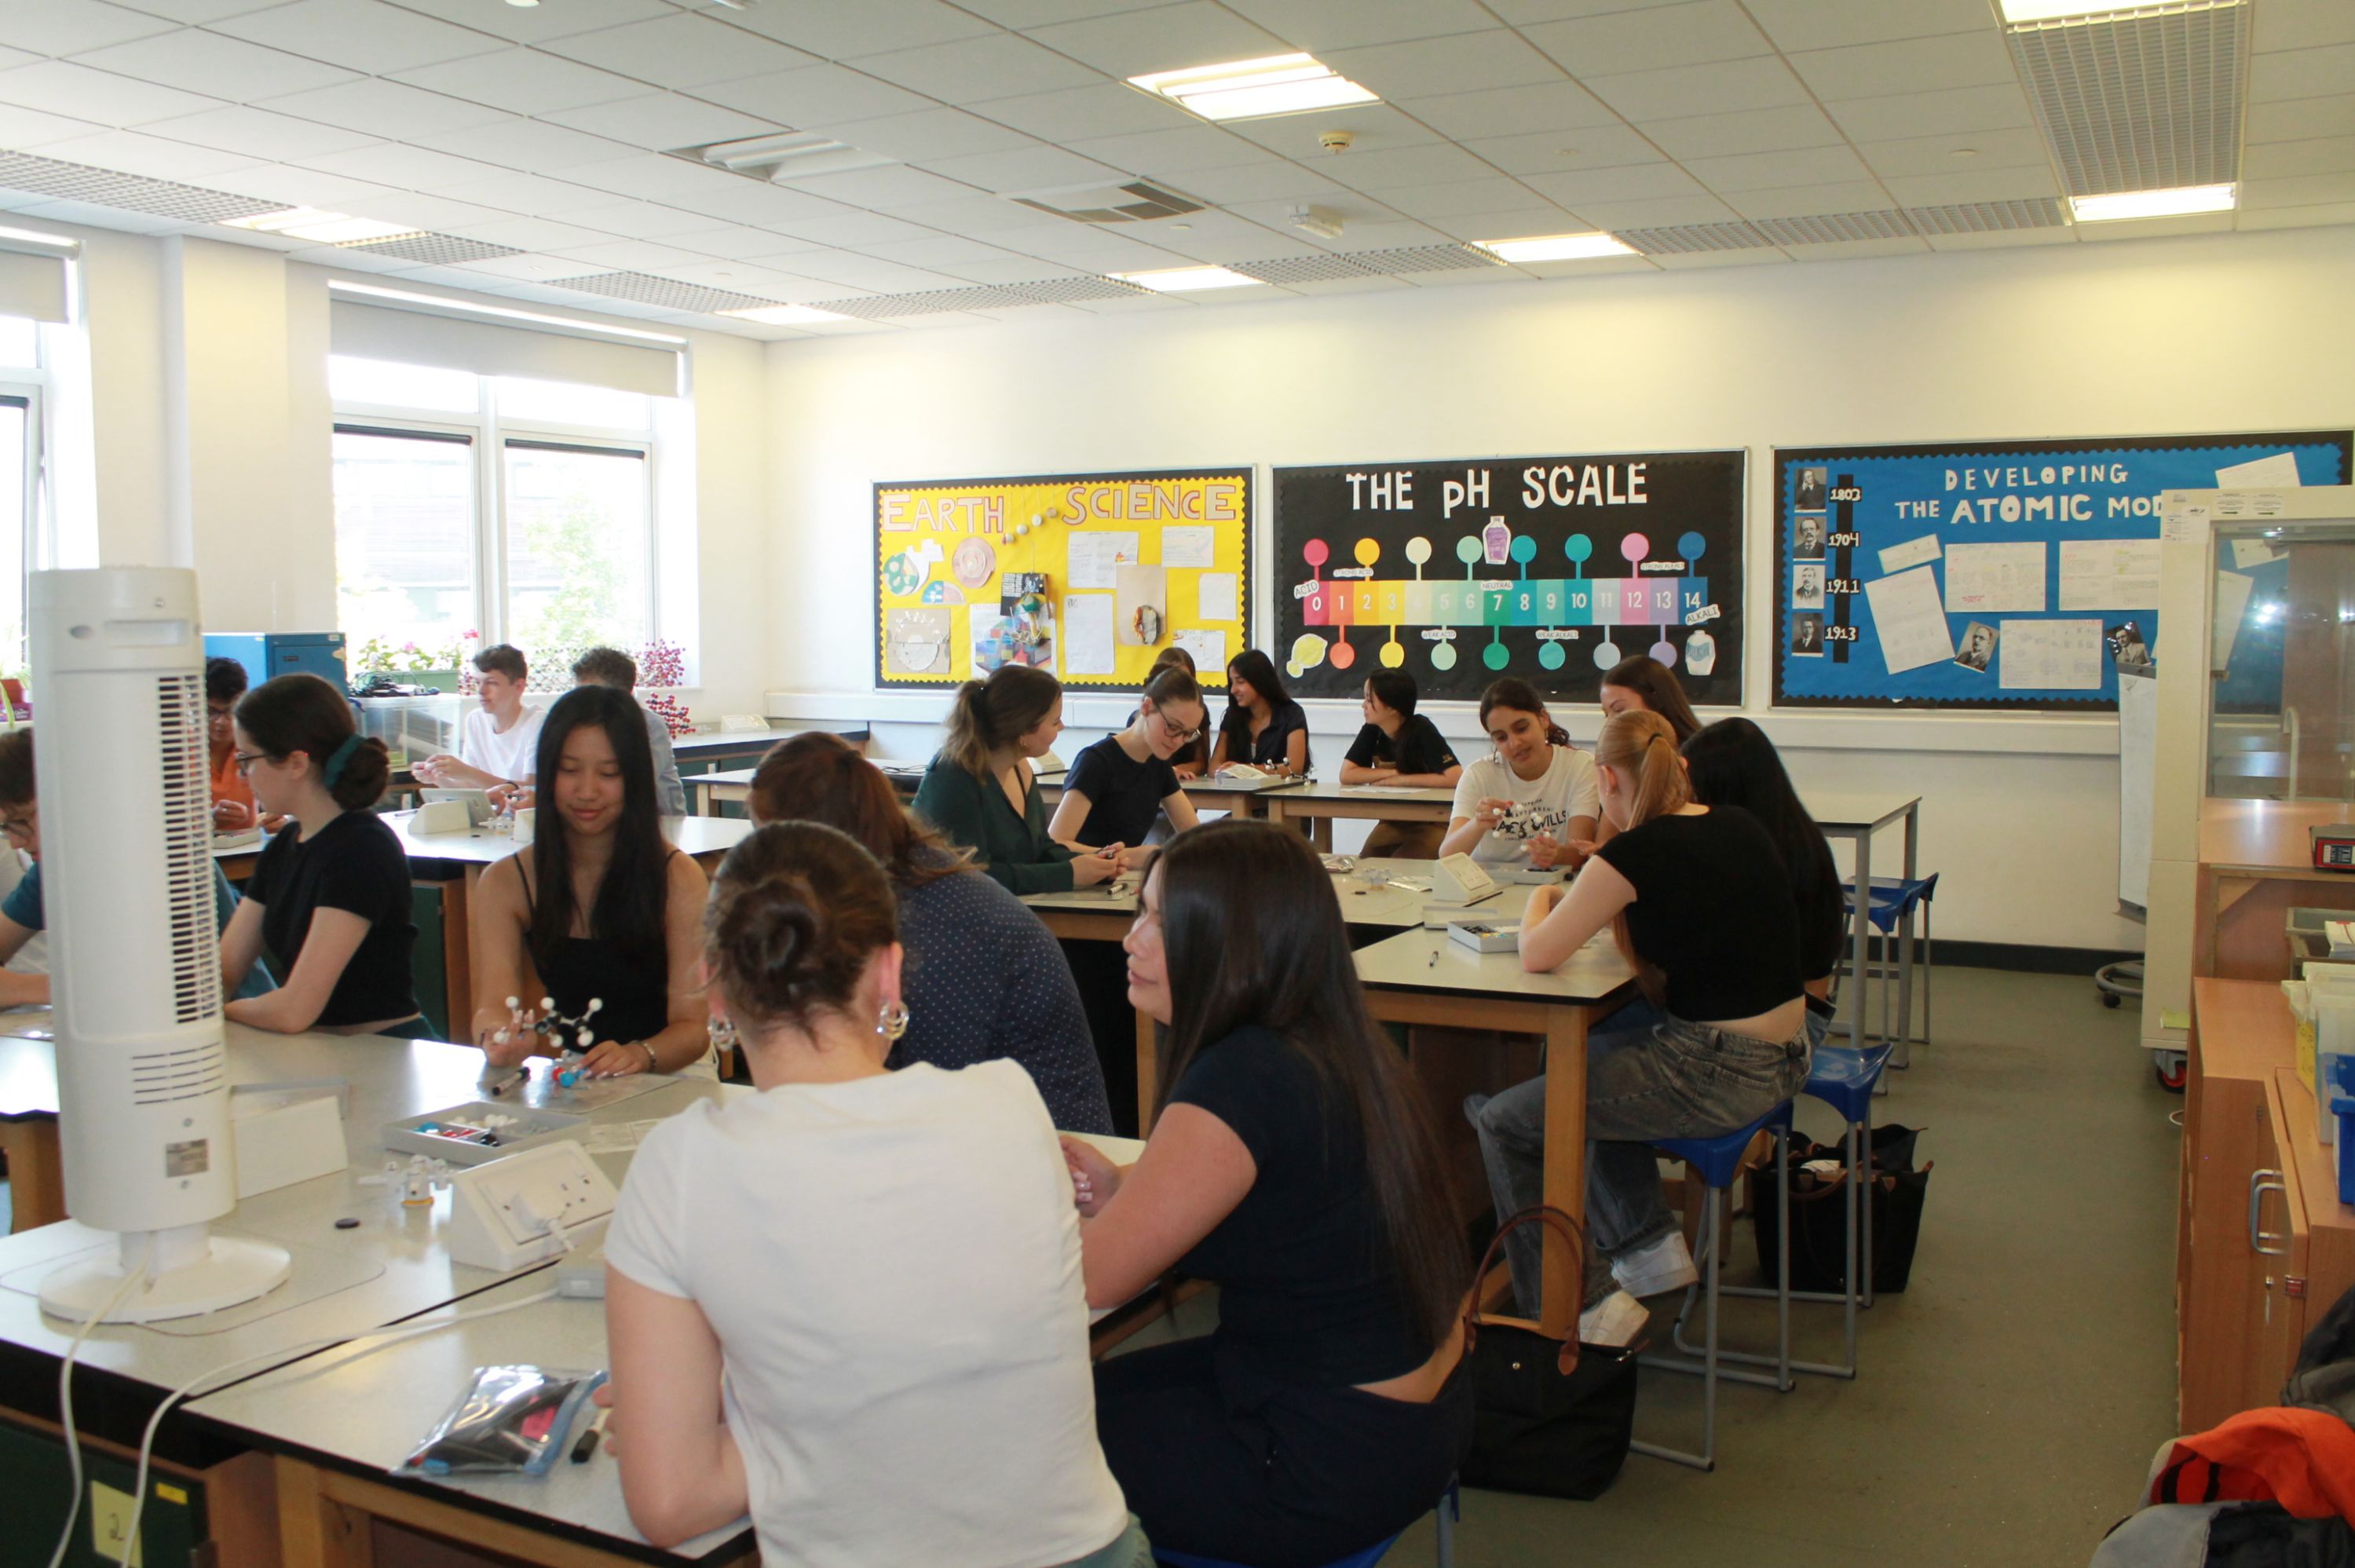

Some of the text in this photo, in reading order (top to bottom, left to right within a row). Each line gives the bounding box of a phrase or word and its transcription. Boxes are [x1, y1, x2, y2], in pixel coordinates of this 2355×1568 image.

[1945, 464, 2129, 492] DEVELOPING
[1345, 462, 1647, 519] THE pH SCALE
[1830, 488, 1861, 502] 1803
[883, 483, 1236, 533] EARTH SCIENCE
[1894, 500, 1940, 519] THE
[1950, 494, 2093, 524] ATOMIC
[1827, 532, 1859, 547] 1904
[1295, 580, 1318, 598] ACID
[1482, 581, 1512, 590] NEUTRAL
[1826, 579, 1860, 594] 1911
[1312, 596, 1322, 611] 0
[1339, 595, 1344, 610] 1
[1362, 594, 1370, 610] 2
[1388, 593, 1397, 610] 3
[1440, 594, 1450, 610] 5
[1465, 593, 1475, 609] 6
[1494, 594, 1503, 611] 7
[1520, 594, 1530, 611] 8
[1546, 593, 1556, 610] 9
[1571, 593, 1587, 609] 10
[1600, 592, 1613, 609] 11
[1627, 591, 1643, 609] 12
[1655, 591, 1672, 609] 13
[1684, 591, 1701, 609] 14
[1686, 607, 1719, 623] ALKALI
[1824, 626, 1856, 641] 1913
[108, 1512, 125, 1541] 2
